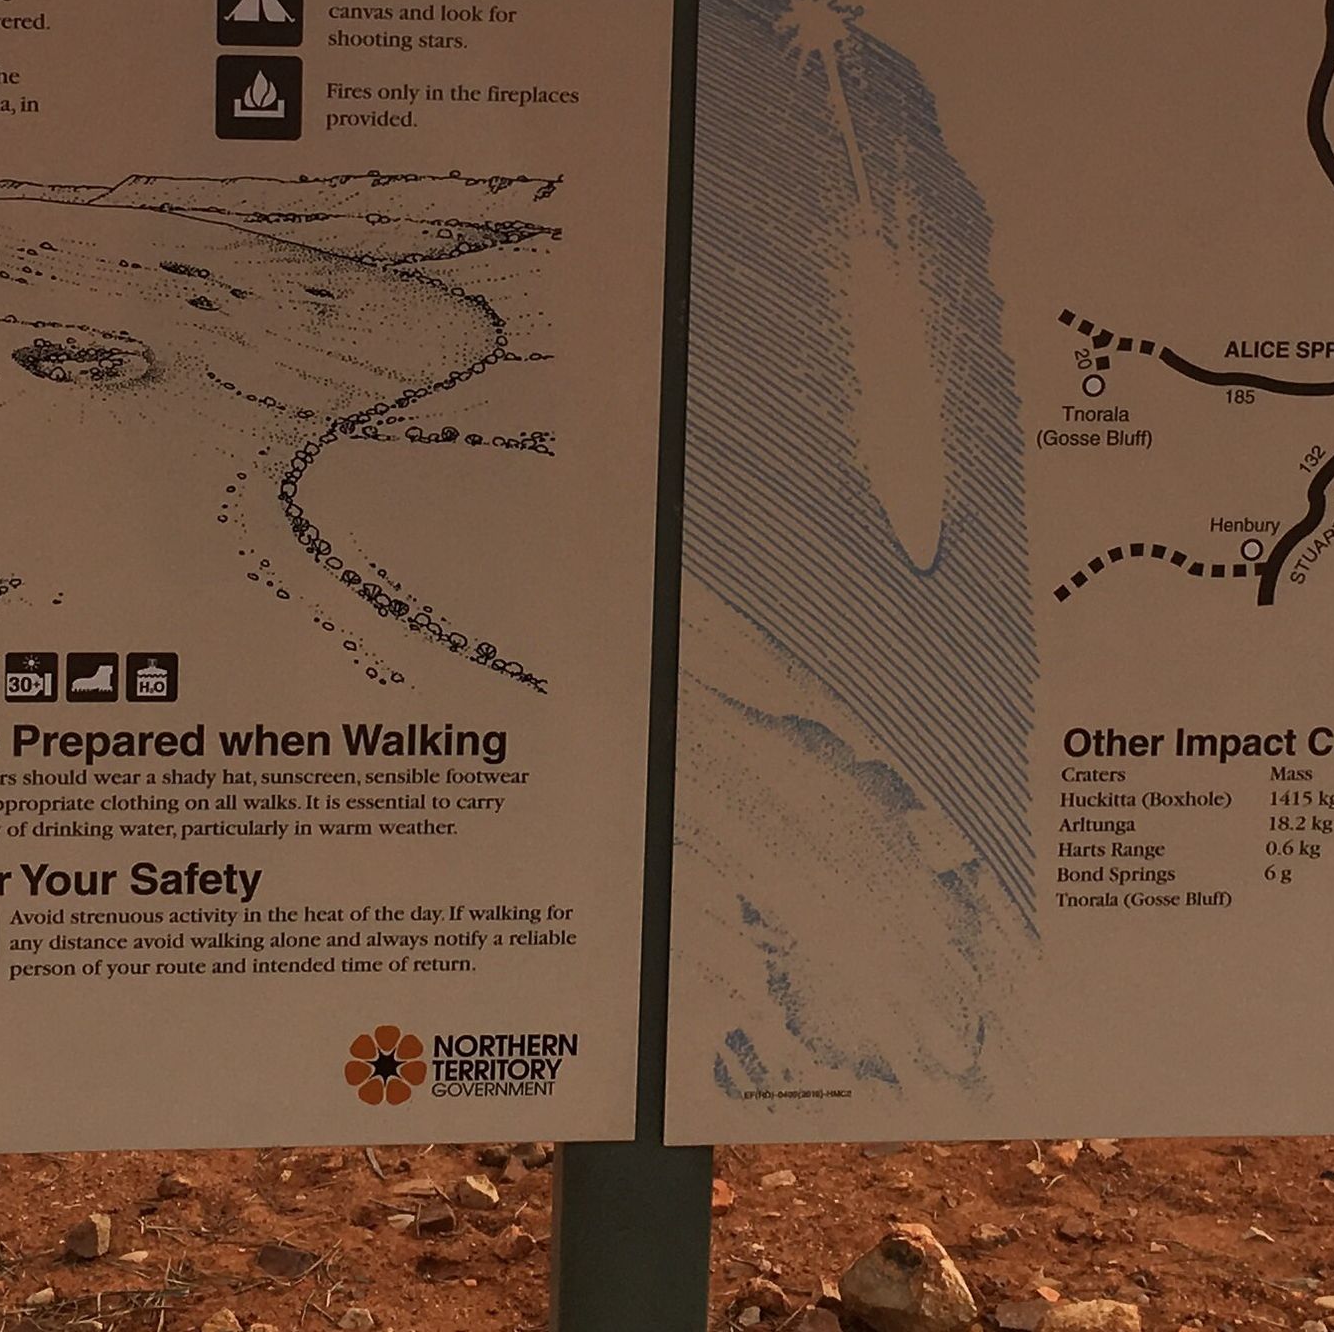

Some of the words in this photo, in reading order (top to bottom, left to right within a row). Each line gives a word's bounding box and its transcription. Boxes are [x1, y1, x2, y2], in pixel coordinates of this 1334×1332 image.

[328, 29, 413, 52] shooting
[418, 34, 468, 49] stars.
[327, 82, 372, 100] Fires
[377, 83, 420, 106] only
[425, 84, 444, 101] in
[450, 84, 481, 102] the
[487, 85, 580, 108] fireplaces
[326, 110, 417, 131] provided.
[1074, 348, 1093, 370] 20
[1224, 340, 1290, 359] ALICE
[1226, 389, 1255, 405] 185
[1061, 405, 1130, 423] Tnorala
[1036, 429, 1101, 450] (Gosse
[1106, 429, 1153, 450] Bluff)
[1299, 445, 1326, 473] 132
[1210, 517, 1281, 539] Henbury
[8, 676, 42, 694] 30+
[13, 723, 205, 766] Prepared
[218, 723, 331, 757] when
[342, 723, 507, 765] Walking
[1063, 727, 1165, 758] Other
[1176, 727, 1297, 764] Impact
[1061, 767, 1126, 782] Craters
[1270, 766, 1313, 782] Mass
[1060, 791, 1136, 808] Huckitta
[1141, 790, 1232, 810] (Boxhole)
[1271, 790, 1313, 806] 1415
[1059, 816, 1136, 836] Arltunga
[1270, 816, 1306, 831] 18.2
[1311, 815, 1333, 835] kg
[19, 863, 118, 897] Your
[130, 862, 262, 904] Safety
[433, 1033, 578, 1059] NORTHERN
[431, 1058, 563, 1082] TERRITORY
[431, 1081, 554, 1098] GOVERNMENT
